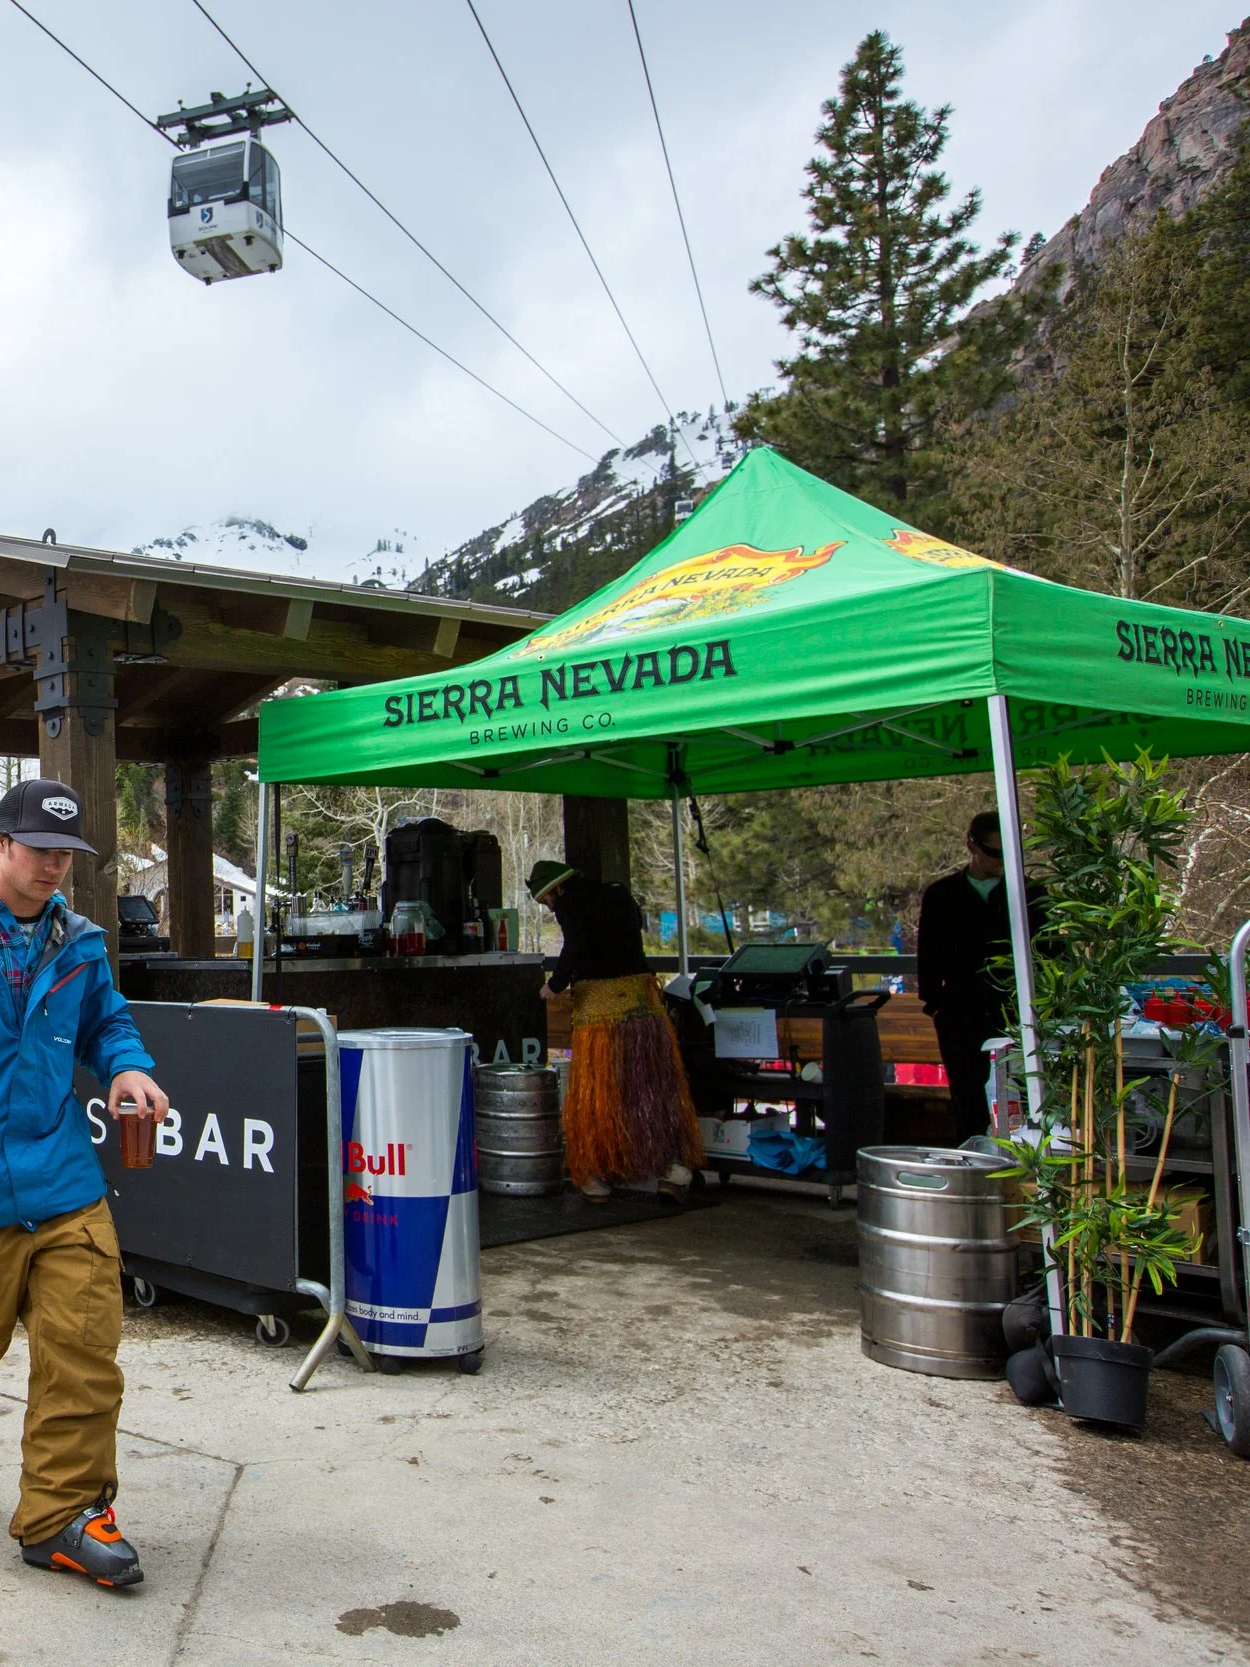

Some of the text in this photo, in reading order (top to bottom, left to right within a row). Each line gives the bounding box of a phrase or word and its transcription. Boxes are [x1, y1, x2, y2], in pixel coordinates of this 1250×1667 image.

[661, 566, 774, 592] NEVADA
[1116, 620, 1218, 679] SIERRA
[382, 639, 739, 728] SIERRA NEVADA
[1186, 688, 1248, 711] BREWING
[470, 712, 617, 745] BREWING CO.
[348, 1141, 406, 1176] Bull
[353, 1210, 399, 1226] DRINK
[359, 1304, 378, 1320] body
[379, 1309, 395, 1320] and
[397, 1311, 421, 1321] mind.
